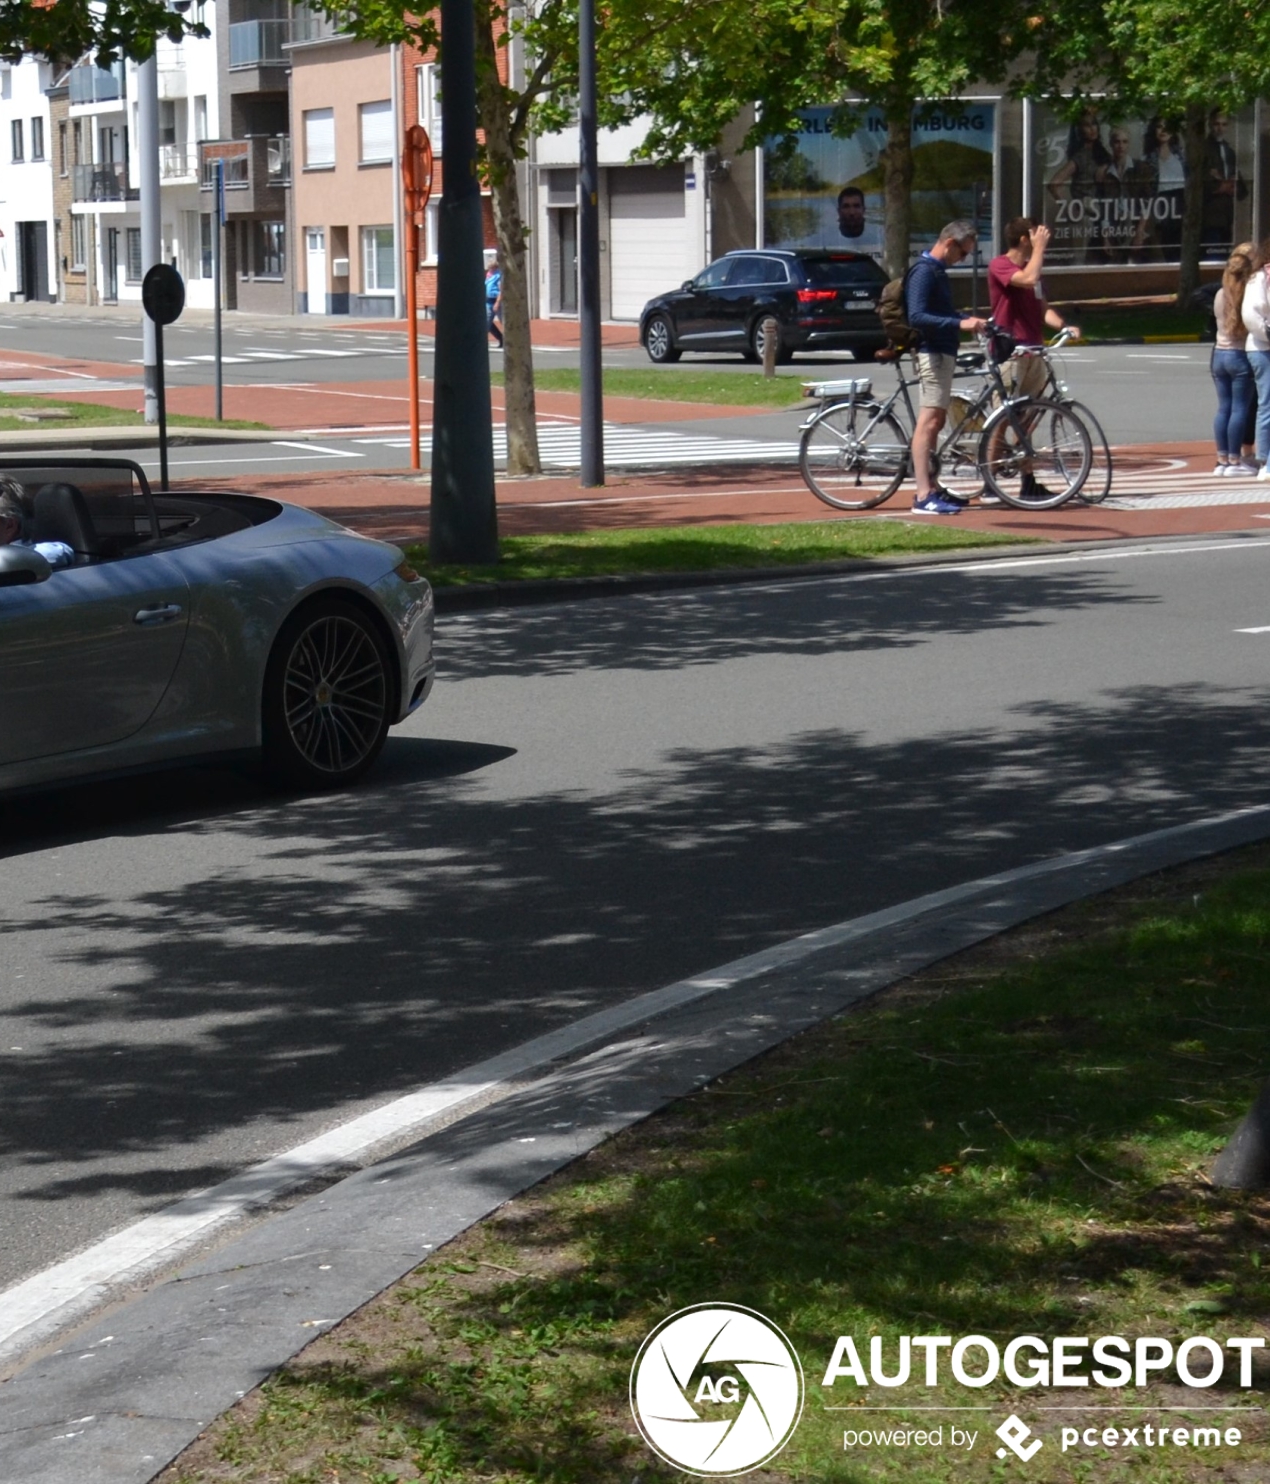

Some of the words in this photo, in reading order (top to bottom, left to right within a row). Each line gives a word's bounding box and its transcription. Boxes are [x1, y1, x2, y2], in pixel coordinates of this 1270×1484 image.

[913, 114, 985, 131] MBURG
[1055, 199, 1084, 222] ZO
[1089, 197, 1182, 221] STIJLVOL
[1055, 227, 1070, 239] ZIE
[1072, 226, 1083, 238] IK
[1084, 226, 1099, 238] ME
[1101, 225, 1136, 238] GRAAG
